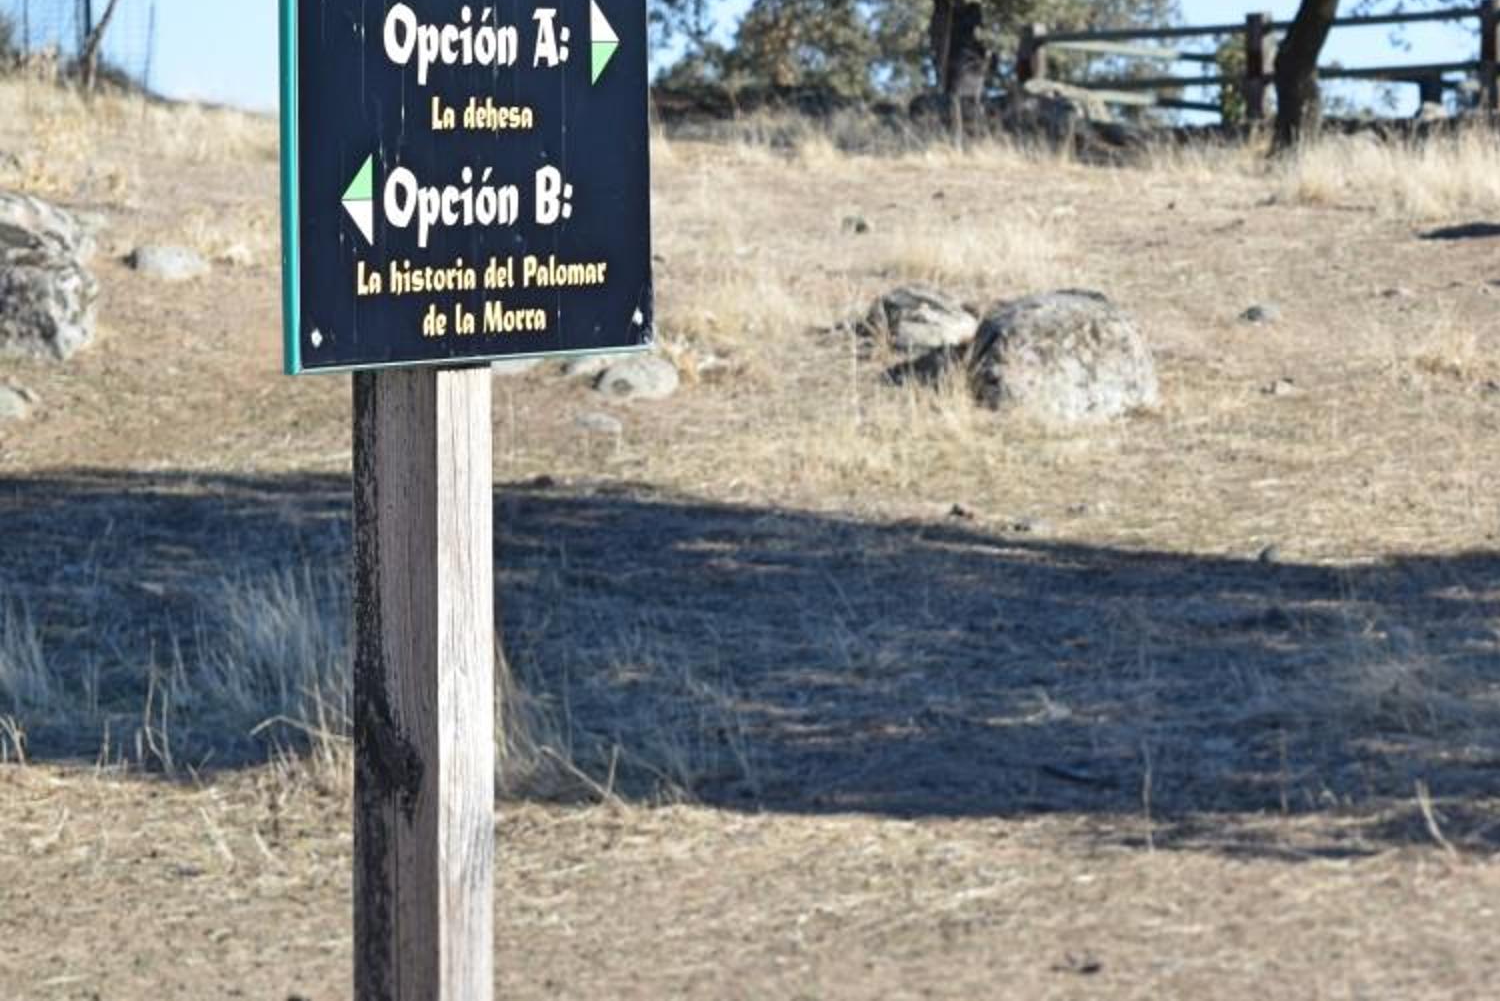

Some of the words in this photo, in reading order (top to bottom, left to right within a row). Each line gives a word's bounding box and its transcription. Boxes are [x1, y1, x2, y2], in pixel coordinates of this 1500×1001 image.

[382, 2, 519, 86] Opción
[532, 7, 571, 68] A:
[431, 95, 456, 131] La
[463, 96, 534, 132] dehesa
[383, 165, 520, 249] Opción
[535, 164, 574, 226] B:
[356, 260, 382, 296] La
[389, 256, 477, 296] historia
[483, 254, 515, 290] del
[522, 254, 608, 288] Palomar
[422, 303, 448, 338] de
[455, 302, 476, 336] la
[482, 300, 547, 334] Morra
